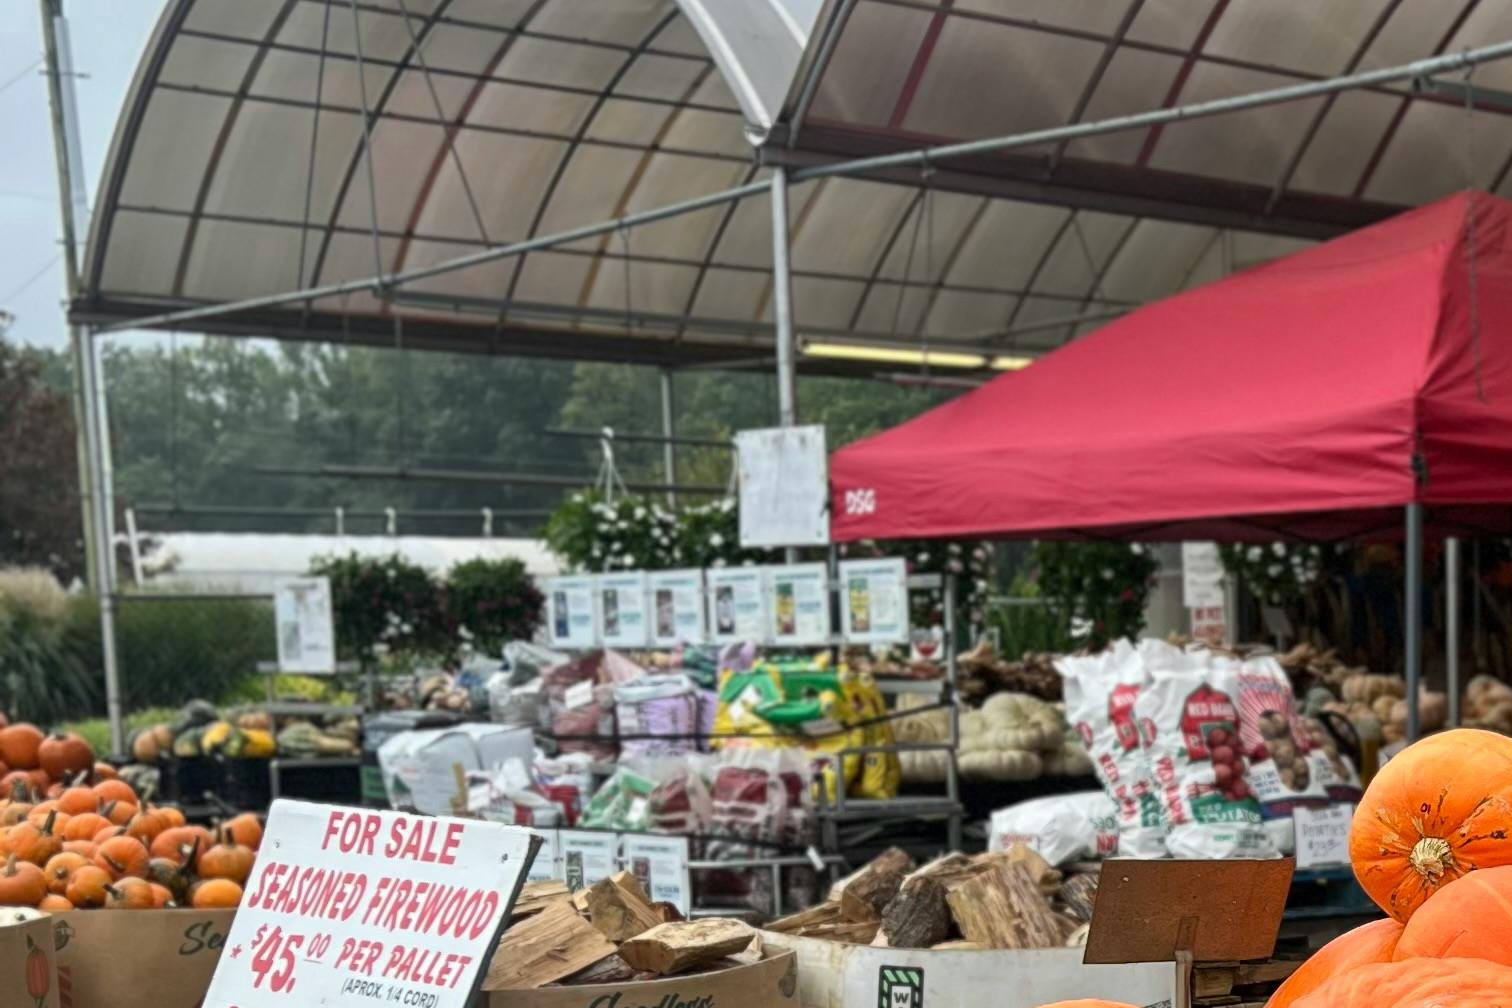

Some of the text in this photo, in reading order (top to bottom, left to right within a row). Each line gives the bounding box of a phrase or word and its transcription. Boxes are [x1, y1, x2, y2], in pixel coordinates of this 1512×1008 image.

[845, 489, 876, 514] DSG
[321, 811, 465, 865] FOR SALE
[248, 862, 499, 941] SEASONED FIREWOOD
[334, 937, 384, 977] PER
[382, 945, 473, 989] PALLET
[341, 978, 383, 1001] (APROX.
[386, 986, 402, 1002] 1/4
